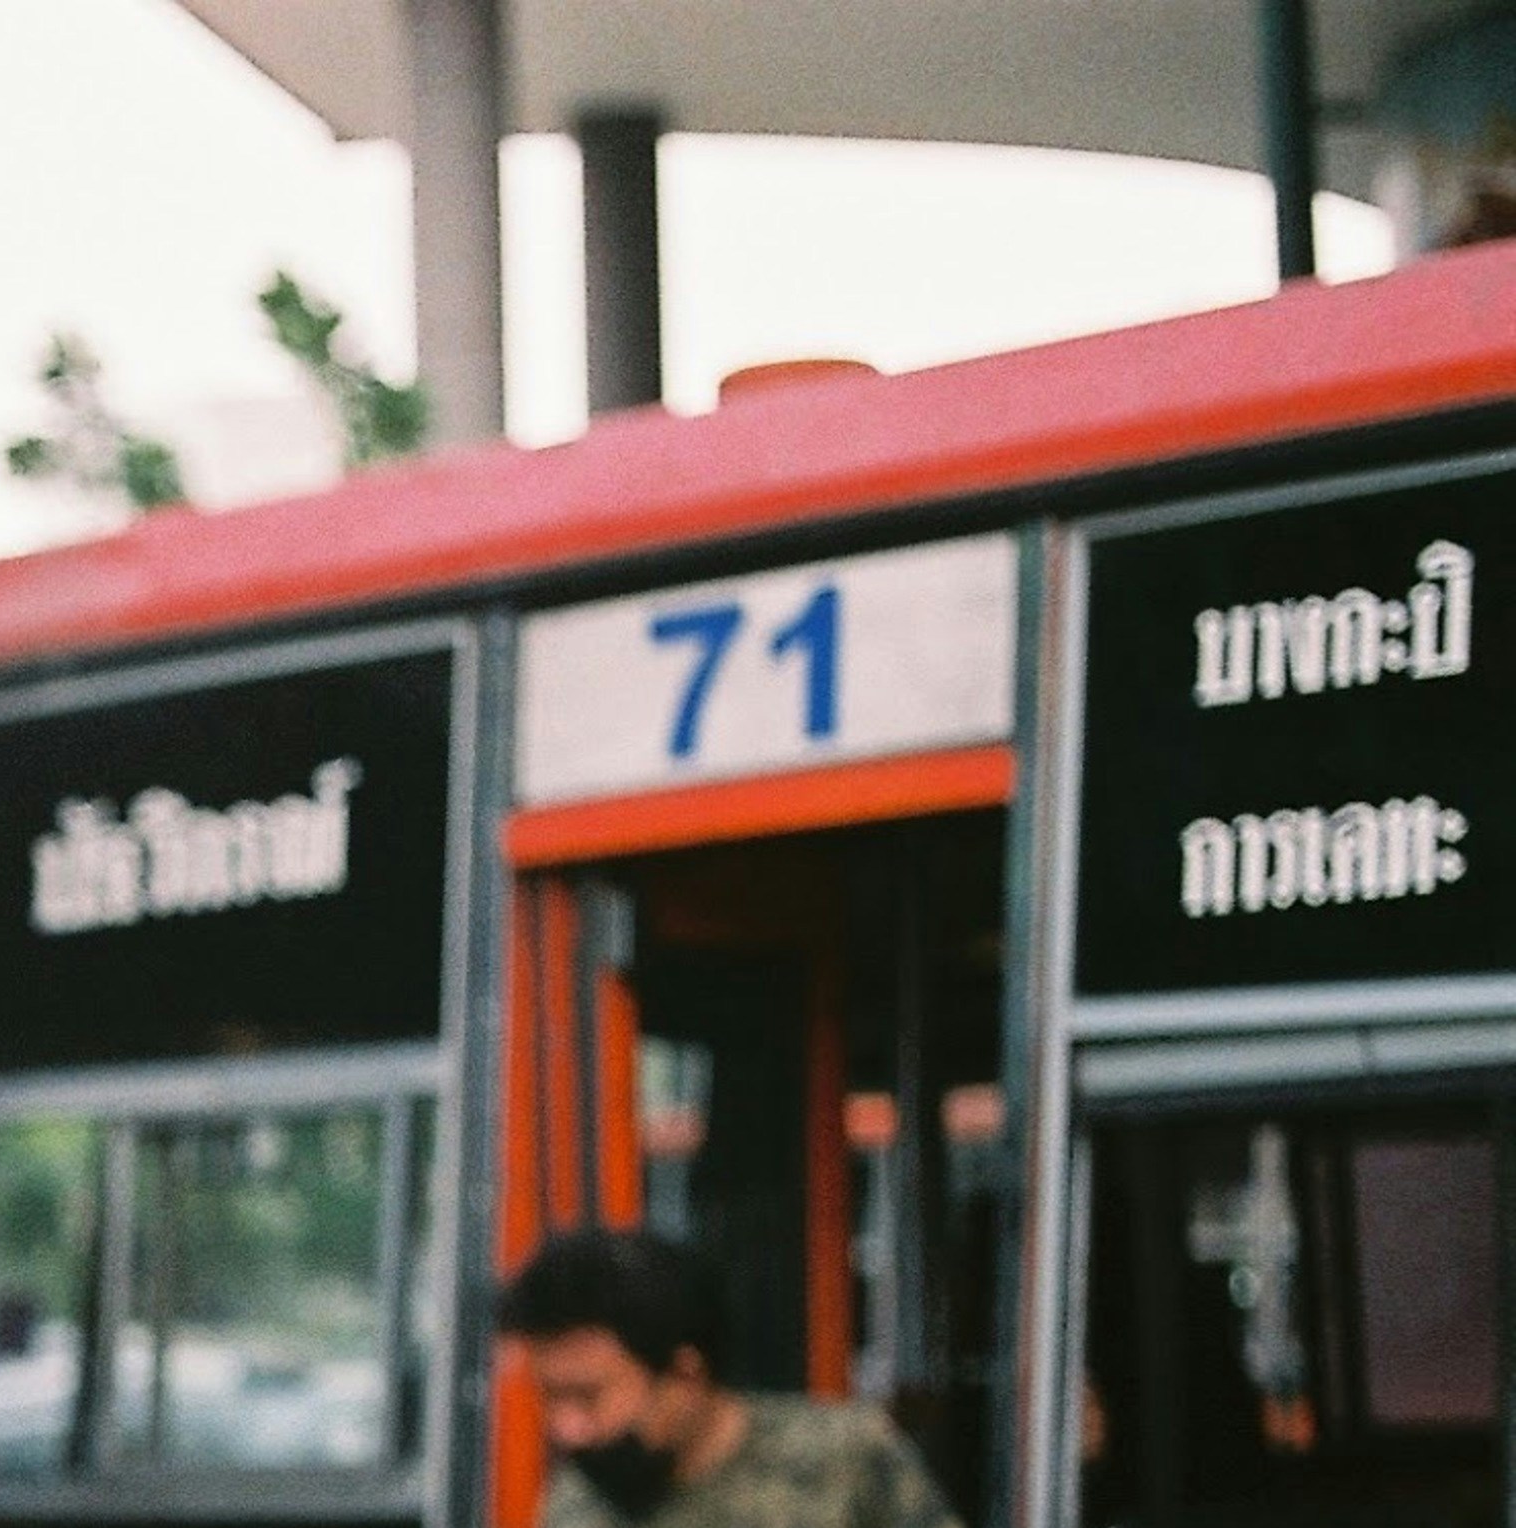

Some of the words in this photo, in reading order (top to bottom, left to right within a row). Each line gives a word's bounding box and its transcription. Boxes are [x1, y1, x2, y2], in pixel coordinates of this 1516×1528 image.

[650, 586, 840, 758] 71
[1194, 539, 1474, 708] บางกะปิ
[1180, 795, 1468, 917] การเคหะ
